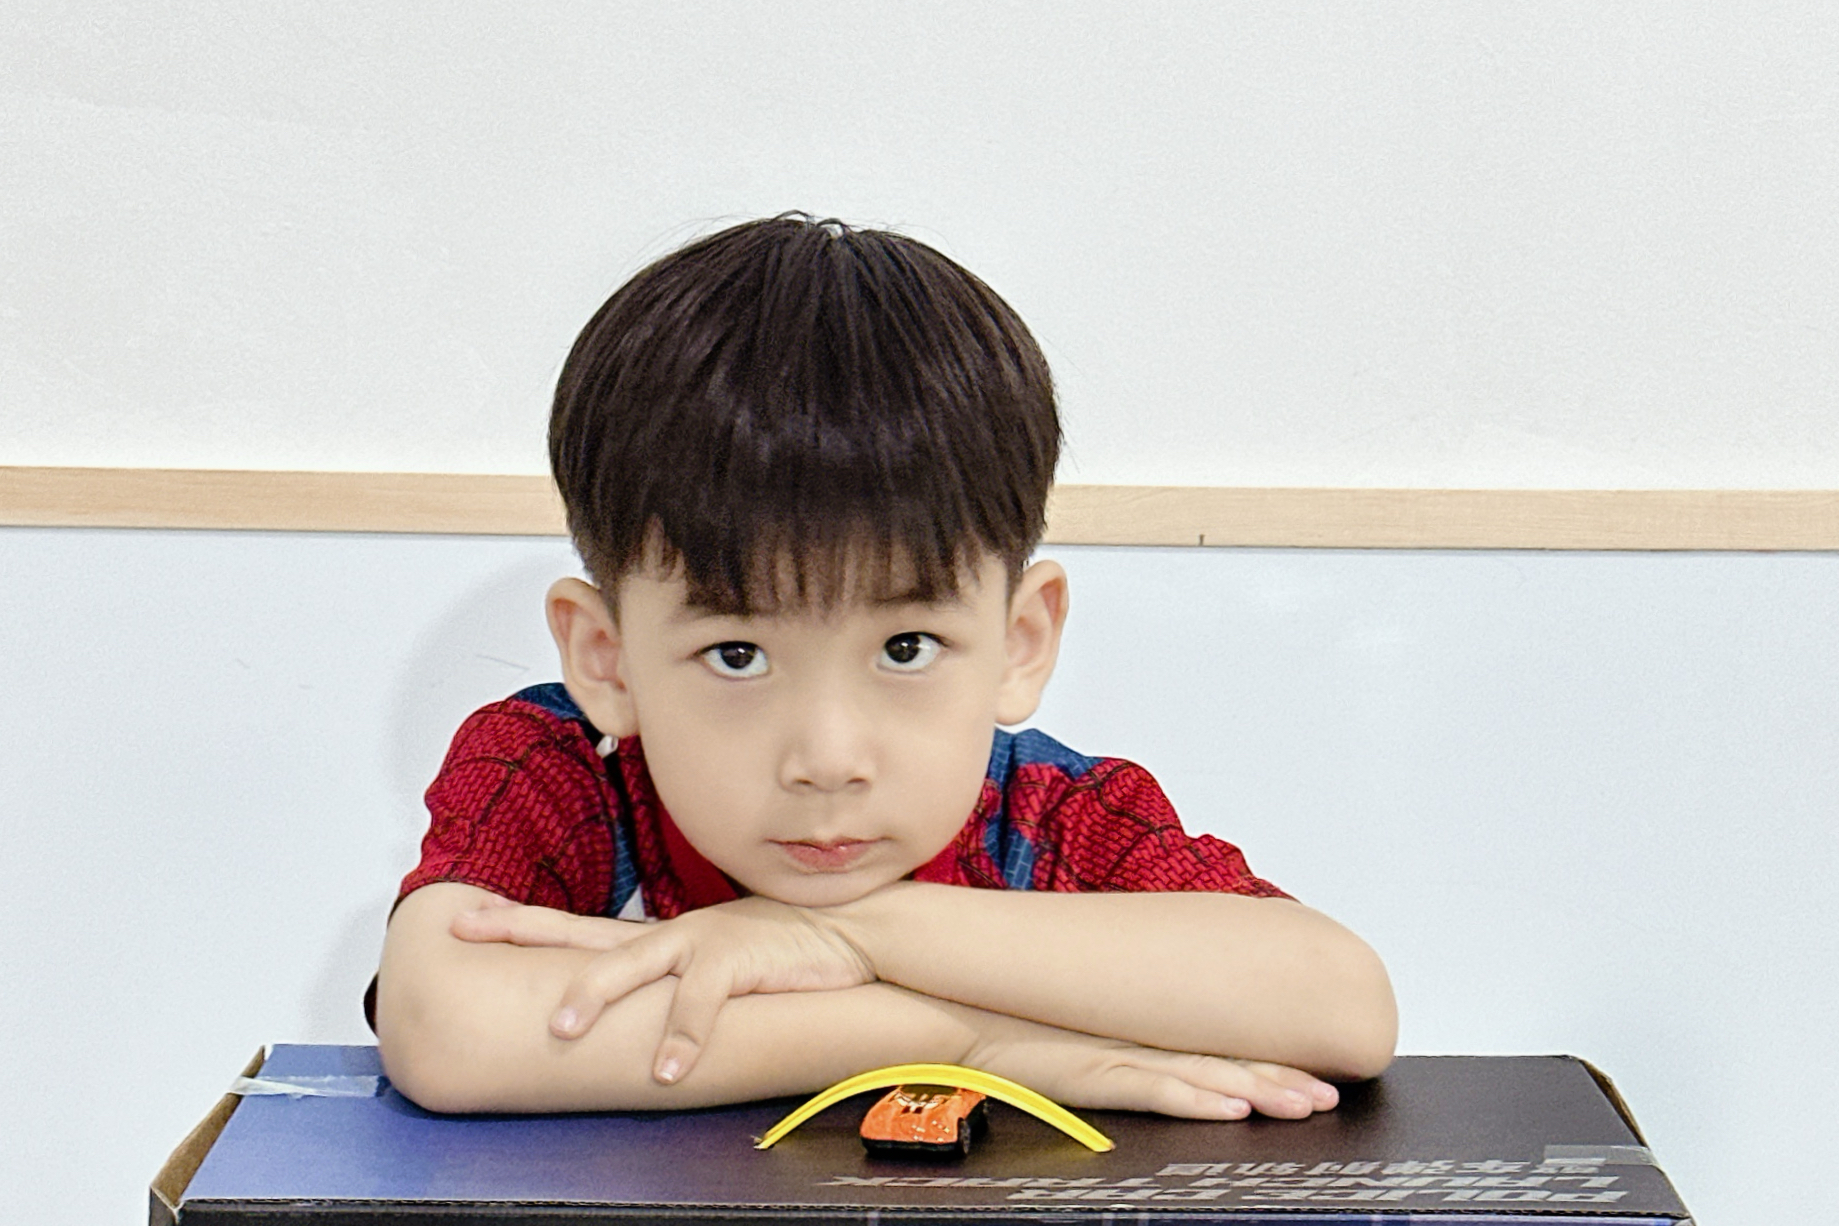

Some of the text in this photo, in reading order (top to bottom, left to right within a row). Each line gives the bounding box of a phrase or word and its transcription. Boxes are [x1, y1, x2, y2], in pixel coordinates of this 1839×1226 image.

[815, 1175, 1620, 1188] LAUNCH TRACK
[1005, 1188, 1629, 1203] POLICE CAR
